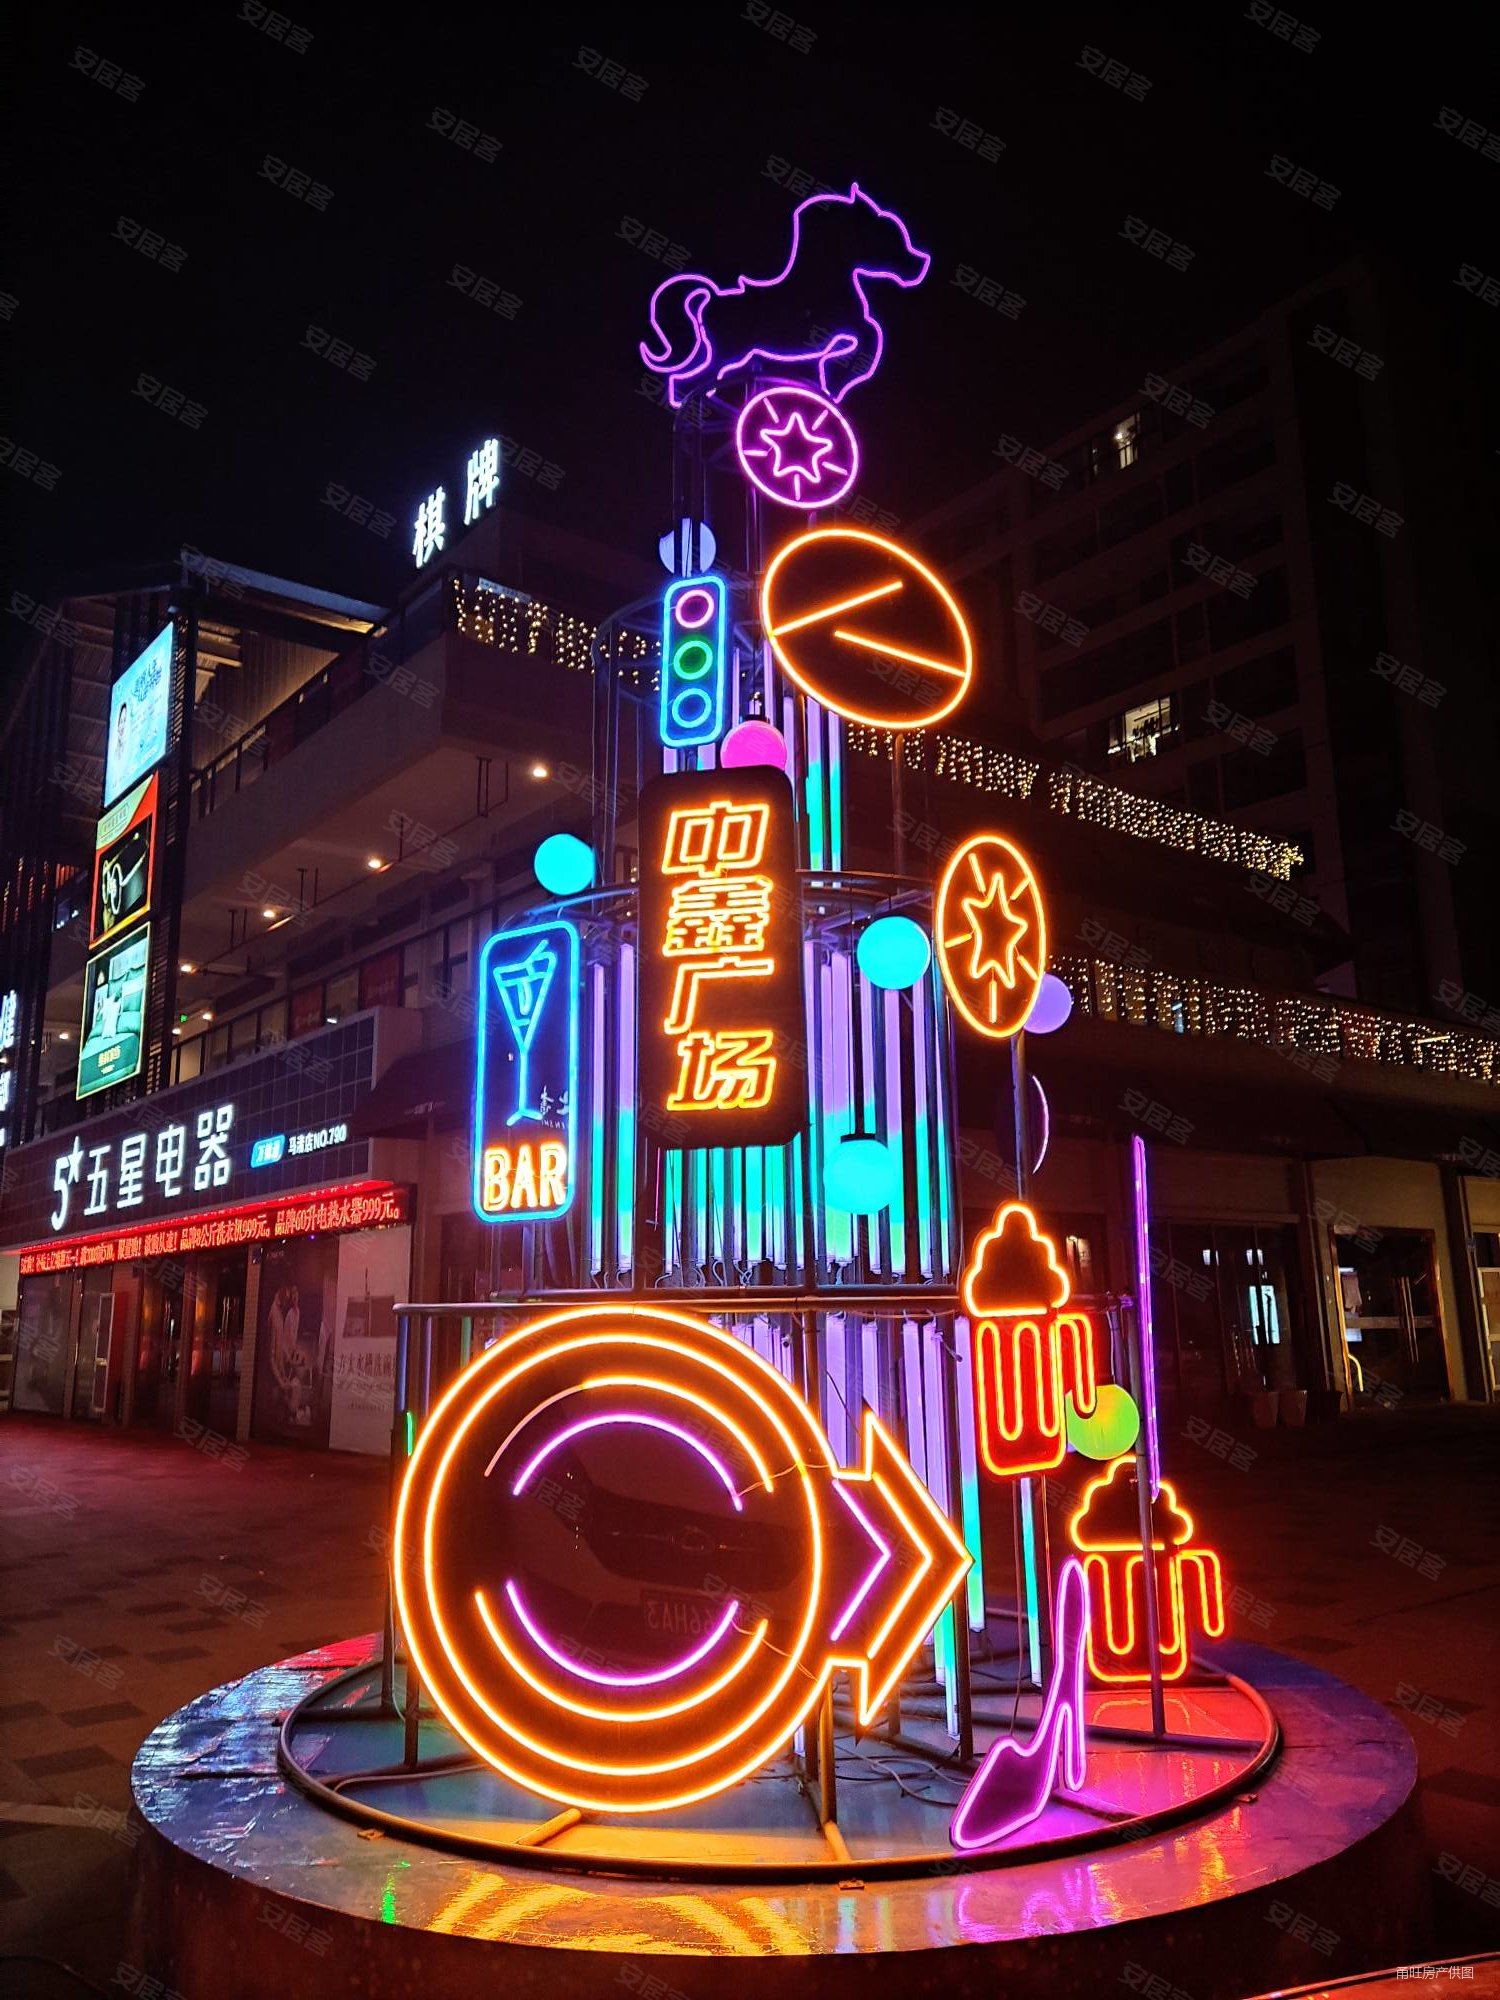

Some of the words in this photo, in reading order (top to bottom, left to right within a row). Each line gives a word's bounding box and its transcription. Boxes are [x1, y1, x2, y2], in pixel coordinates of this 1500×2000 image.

[412, 438, 500, 569] 棋牌
[661, 800, 776, 1112] 中鑫广场
[84, 1103, 235, 1216] 五星电器
[483, 1142, 569, 1212] BAR
